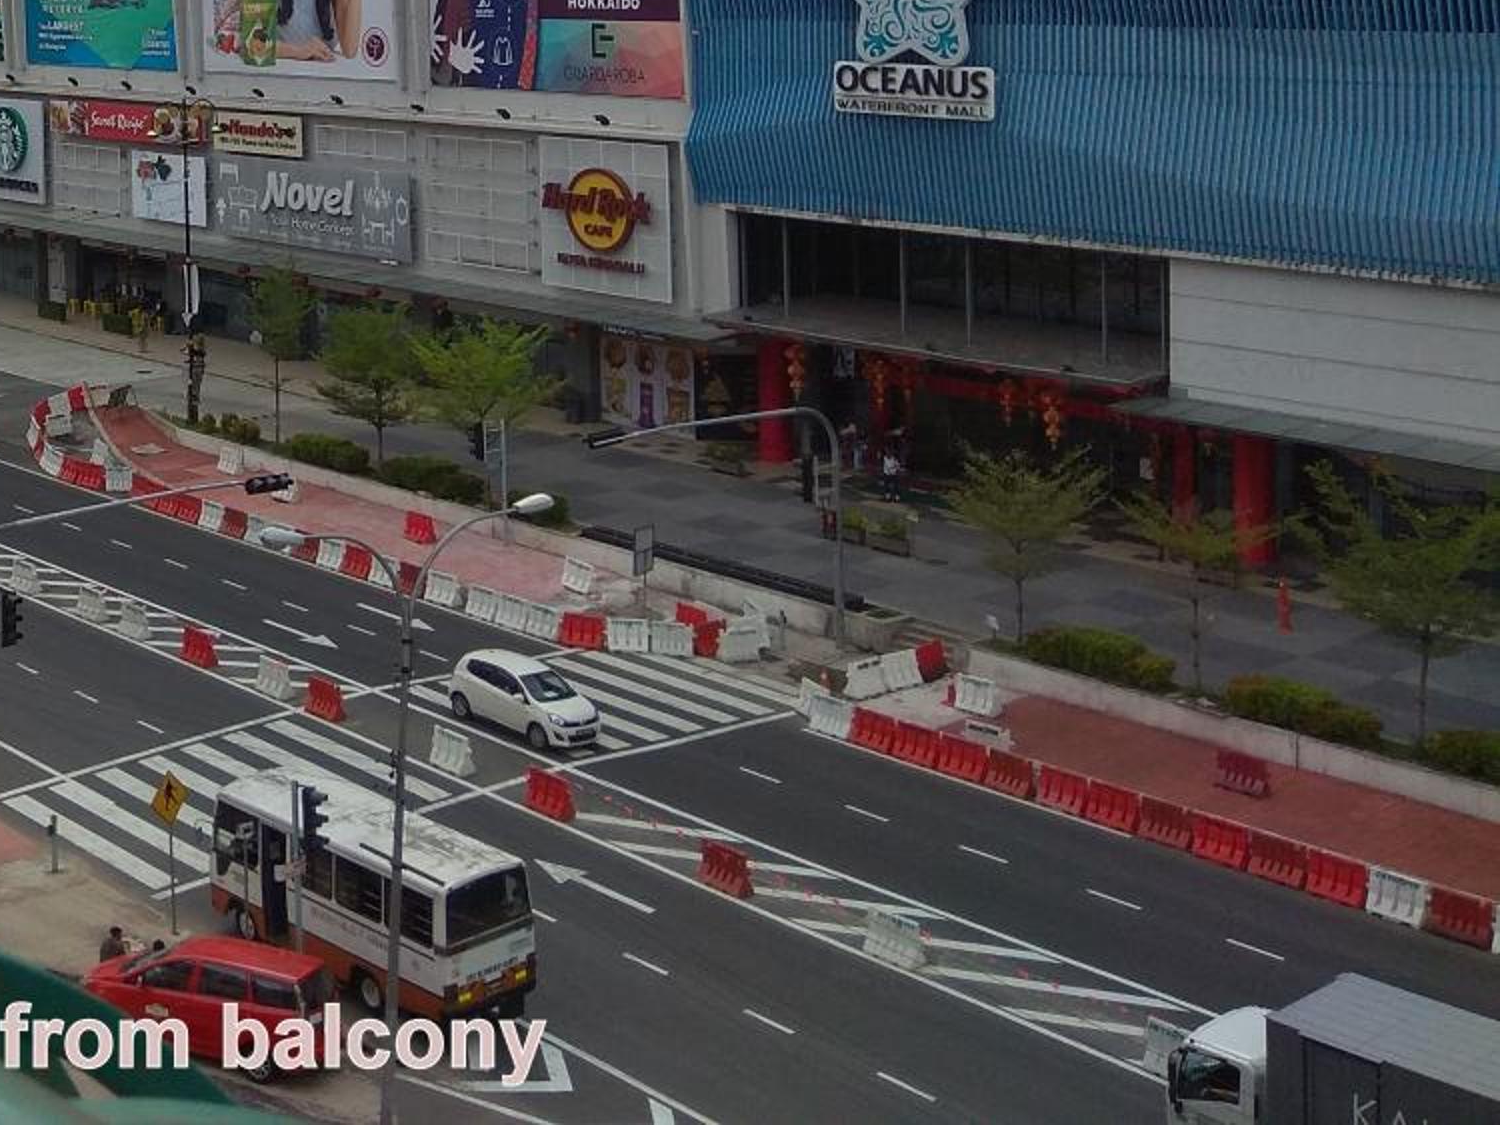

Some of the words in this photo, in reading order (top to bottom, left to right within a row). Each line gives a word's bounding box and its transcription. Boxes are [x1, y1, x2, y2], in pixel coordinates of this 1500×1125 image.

[835, 64, 989, 99] OCEANUS
[836, 98, 939, 115] WATERFRONT
[945, 106, 986, 118] MALL
[261, 170, 354, 216] Novel
